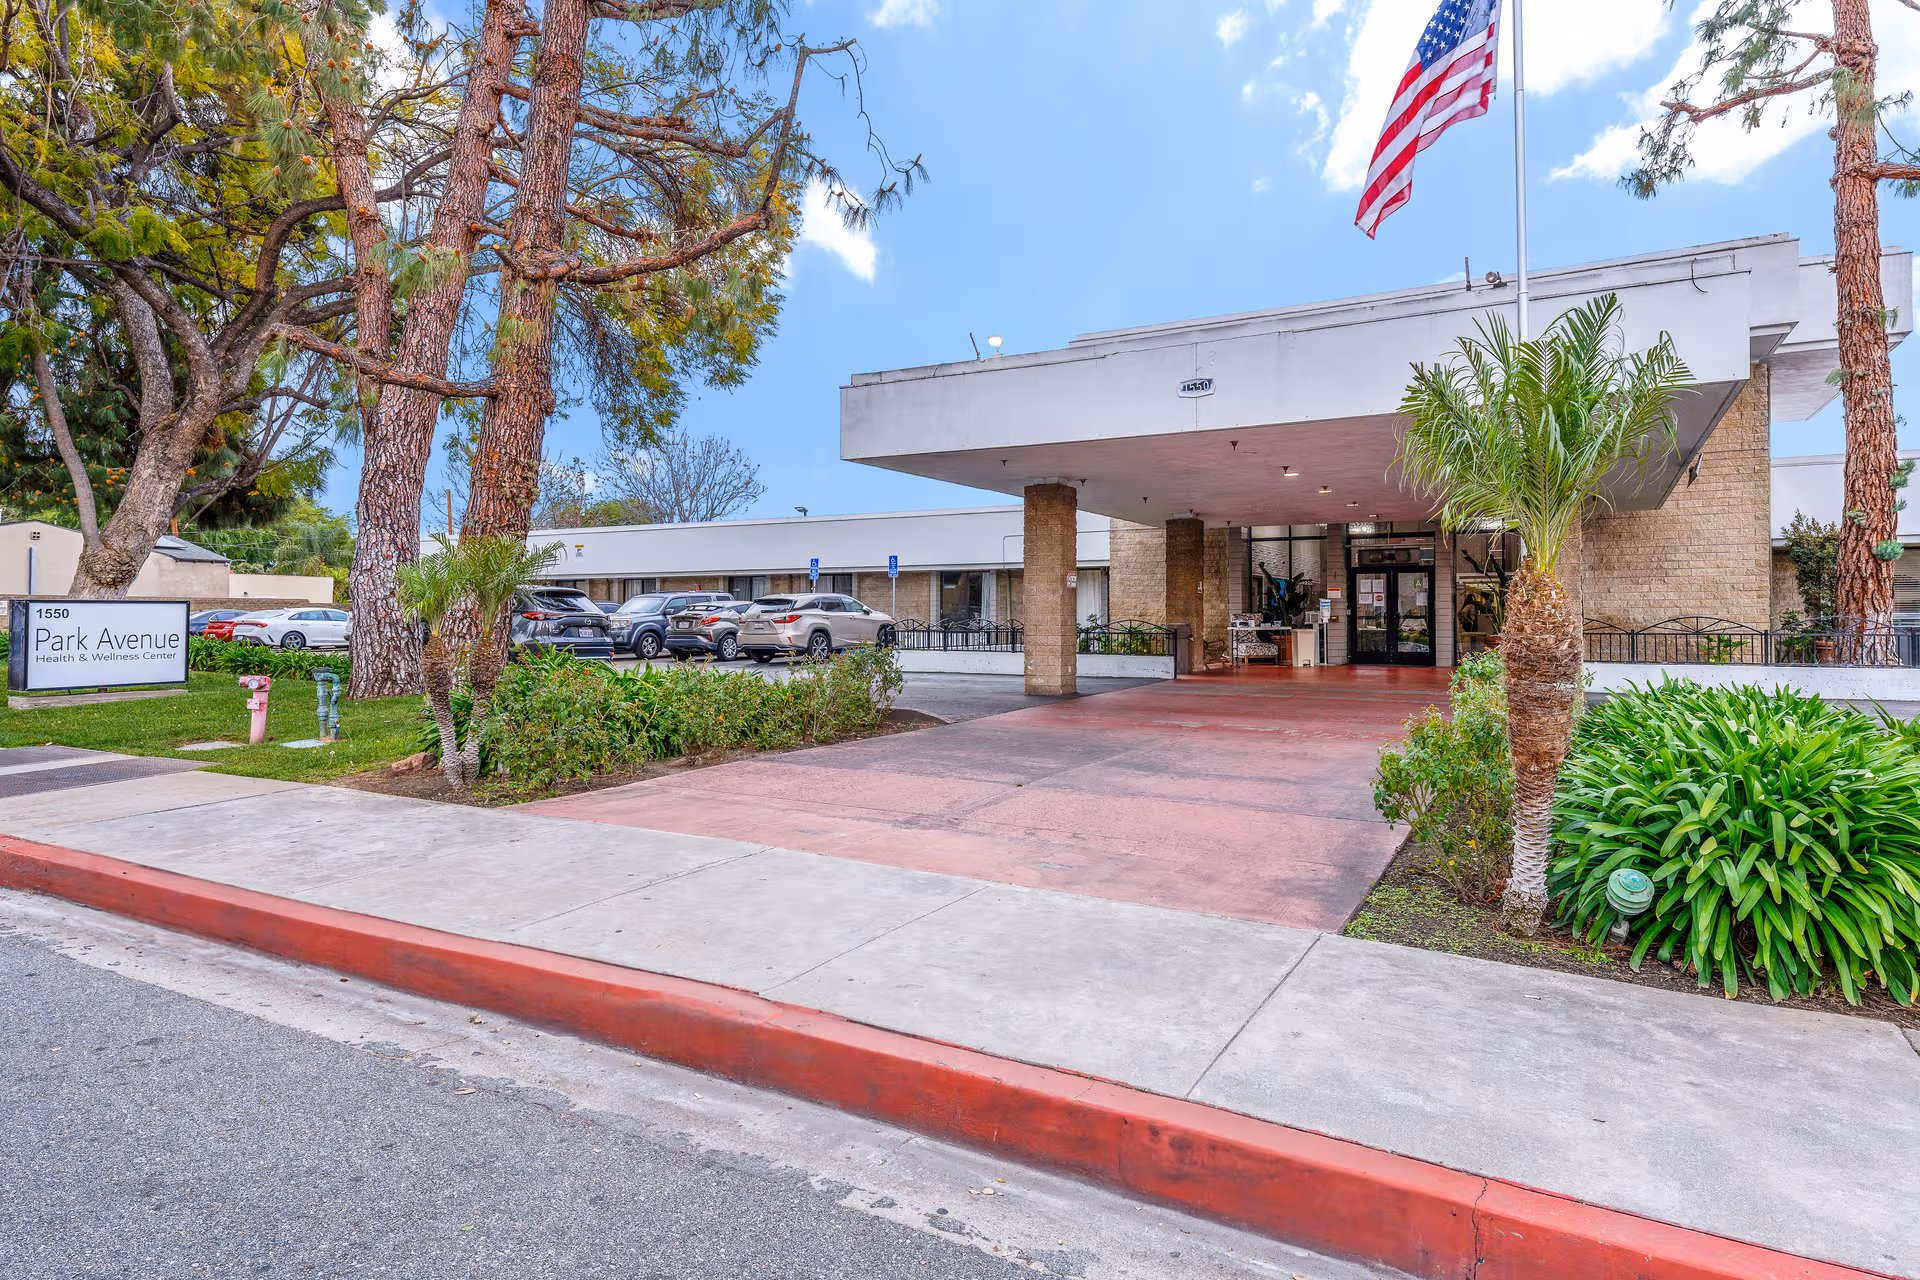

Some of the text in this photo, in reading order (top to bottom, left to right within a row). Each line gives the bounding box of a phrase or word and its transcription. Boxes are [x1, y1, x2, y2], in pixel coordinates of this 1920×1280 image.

[1182, 381, 1210, 391] 1550
[36, 608, 70, 619] 1550
[35, 626, 180, 651] Park Avenue
[35, 651, 177, 663] Health & Wellness Center
